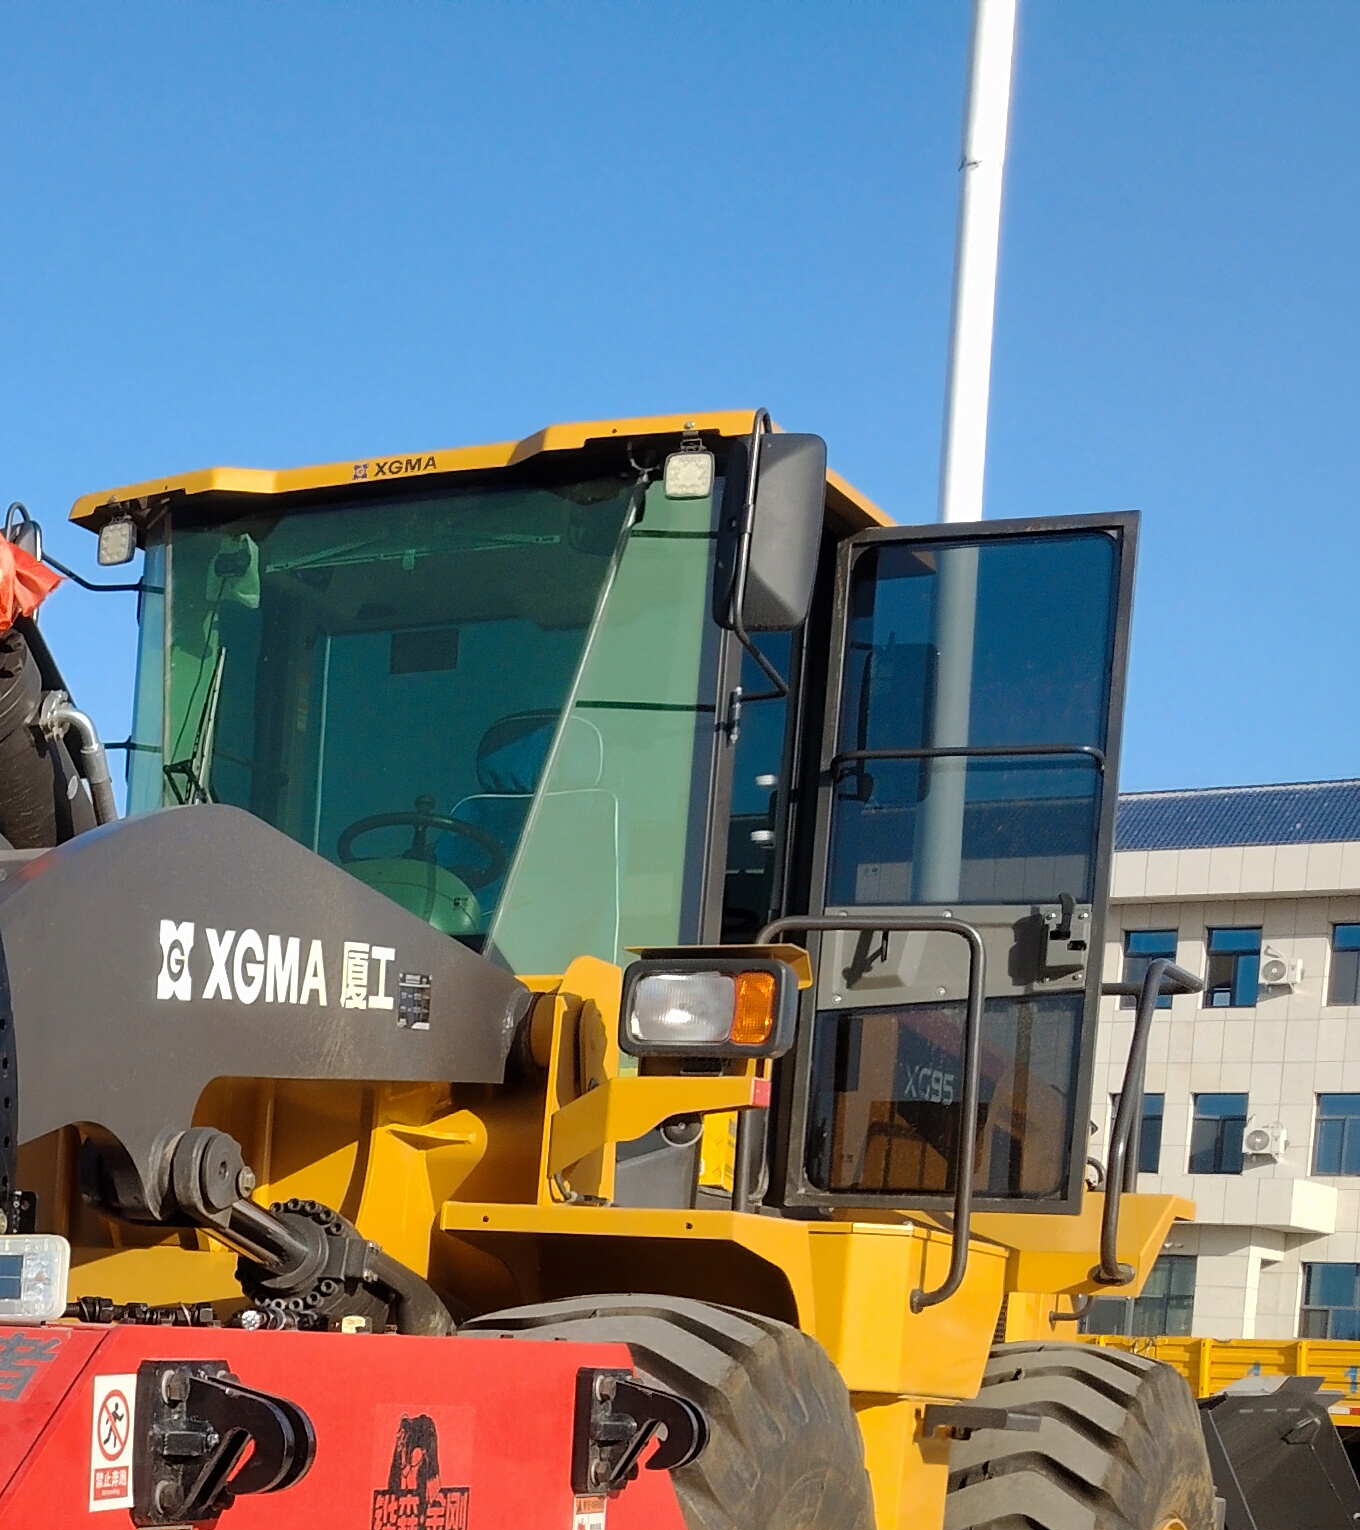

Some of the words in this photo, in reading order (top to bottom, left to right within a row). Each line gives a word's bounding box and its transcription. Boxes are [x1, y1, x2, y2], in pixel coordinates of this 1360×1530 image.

[374, 456, 437, 477] XGMA
[202, 928, 328, 1007] XGMA
[340, 941, 396, 1010] 厦工
